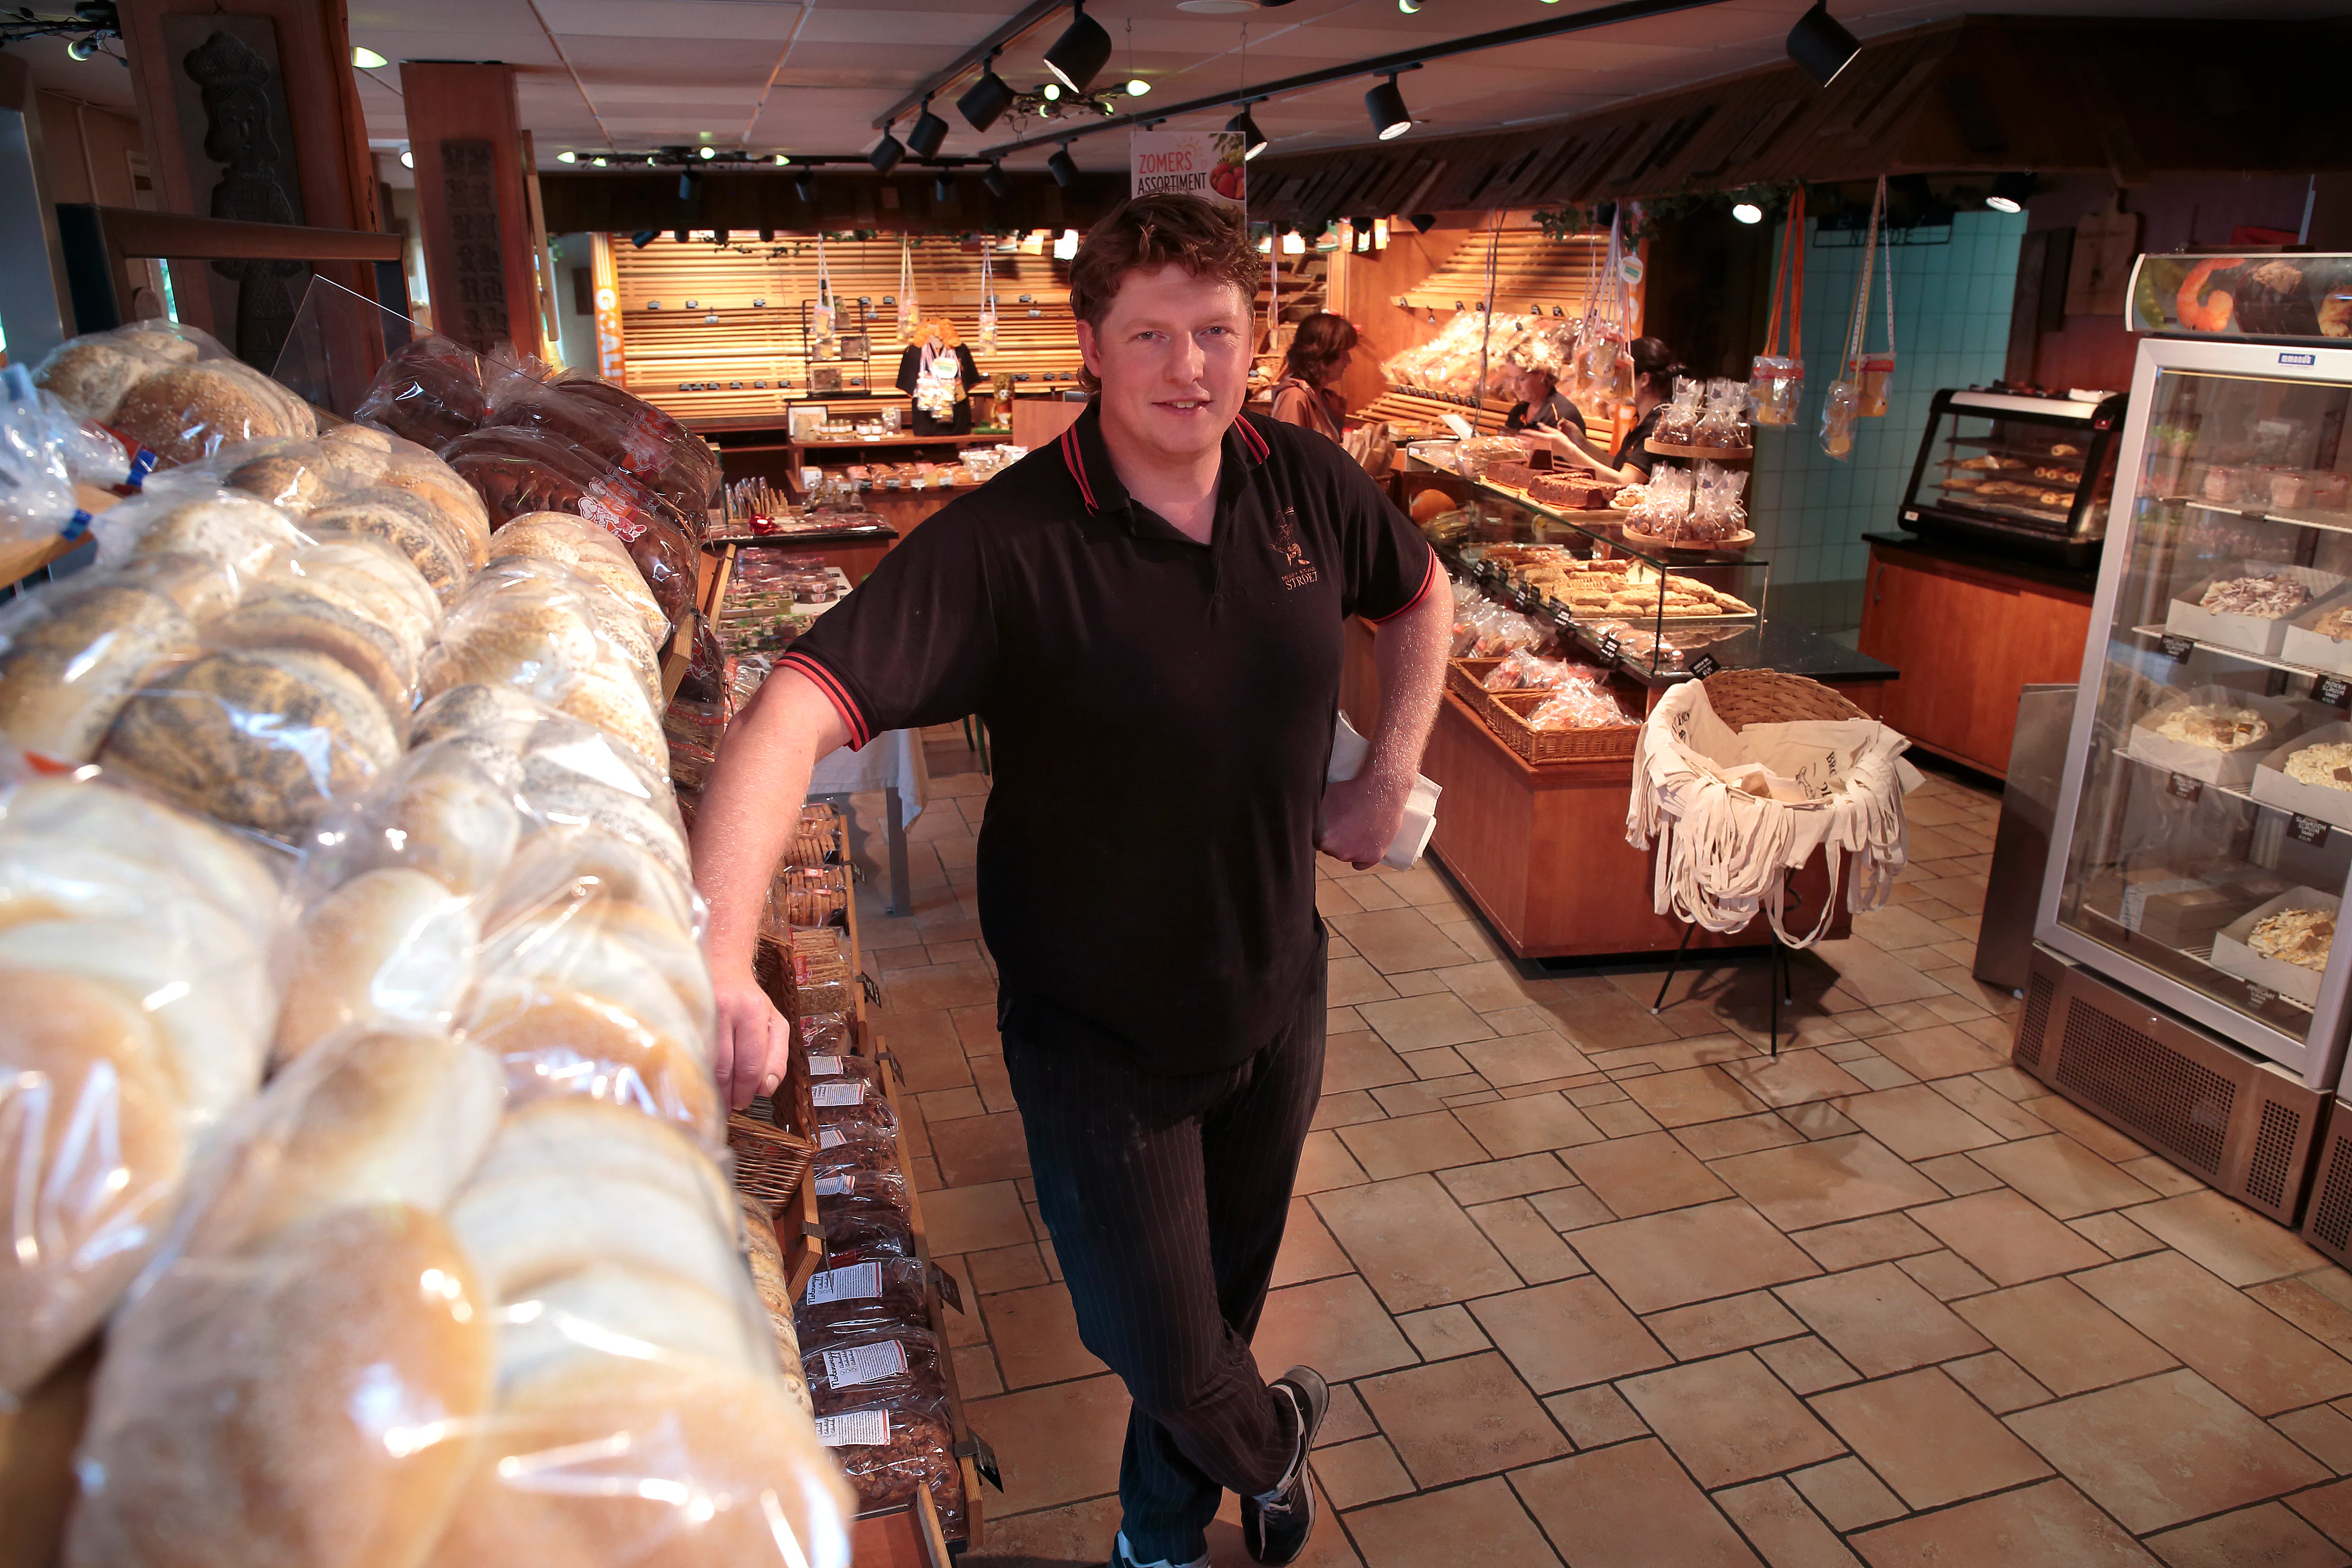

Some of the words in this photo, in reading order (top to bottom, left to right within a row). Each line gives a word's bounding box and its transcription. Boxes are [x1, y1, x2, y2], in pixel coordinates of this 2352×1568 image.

[1139, 151, 1193, 174] ZOMERS
[1137, 172, 1207, 195] ASSORTIMENT
[1285, 571, 1318, 590] STROET
